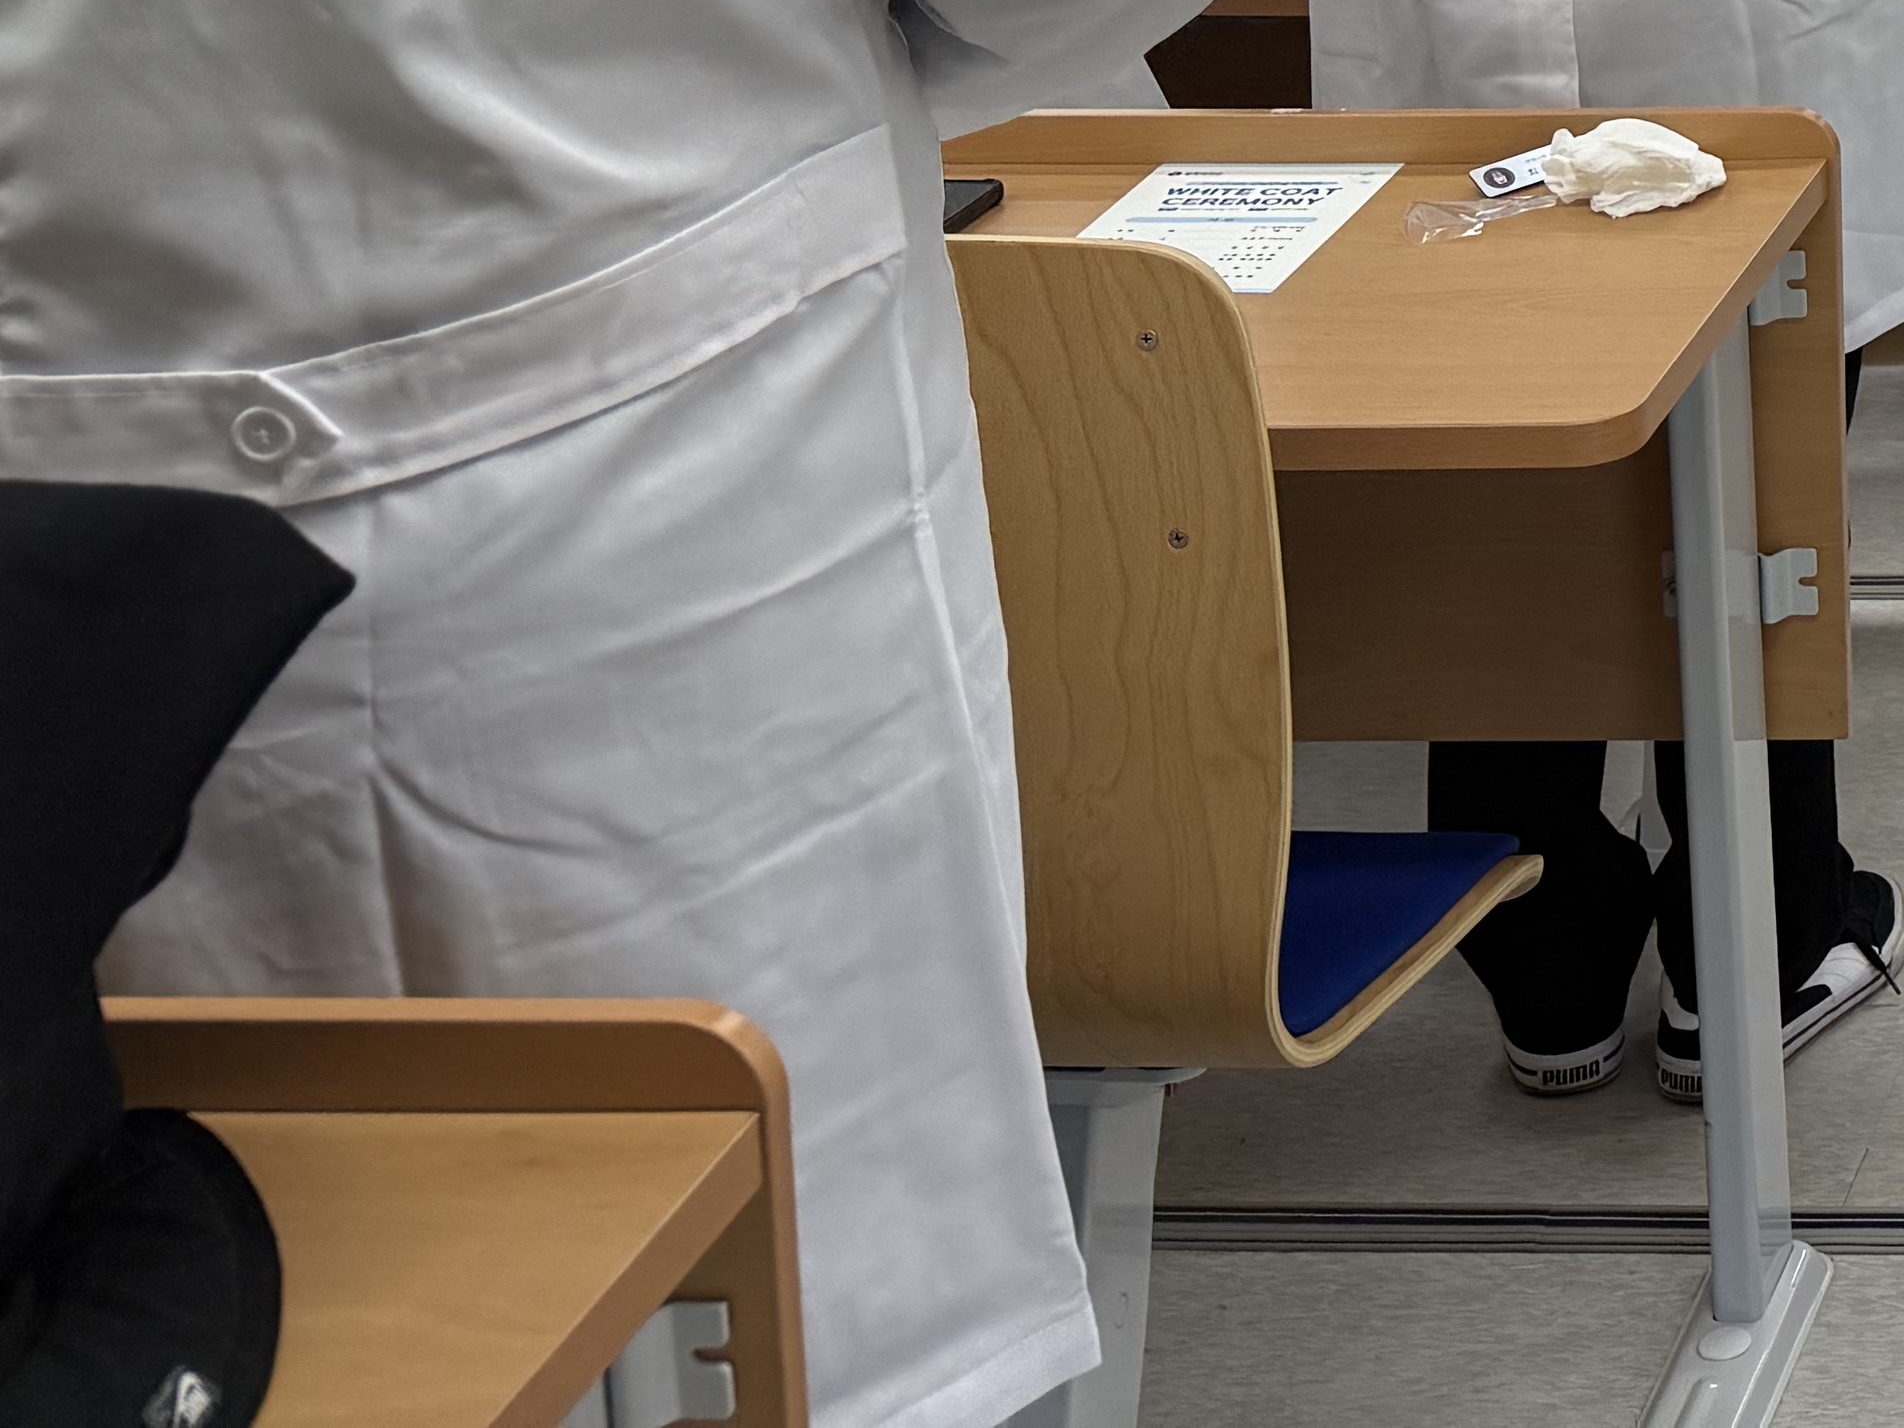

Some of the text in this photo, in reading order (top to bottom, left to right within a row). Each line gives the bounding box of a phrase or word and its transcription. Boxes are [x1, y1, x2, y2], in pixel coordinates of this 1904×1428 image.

[1167, 187, 1343, 196] WHITE COAT
[1161, 197, 1325, 206] CEREMONY
[1542, 1059, 1600, 1086] PUMA
